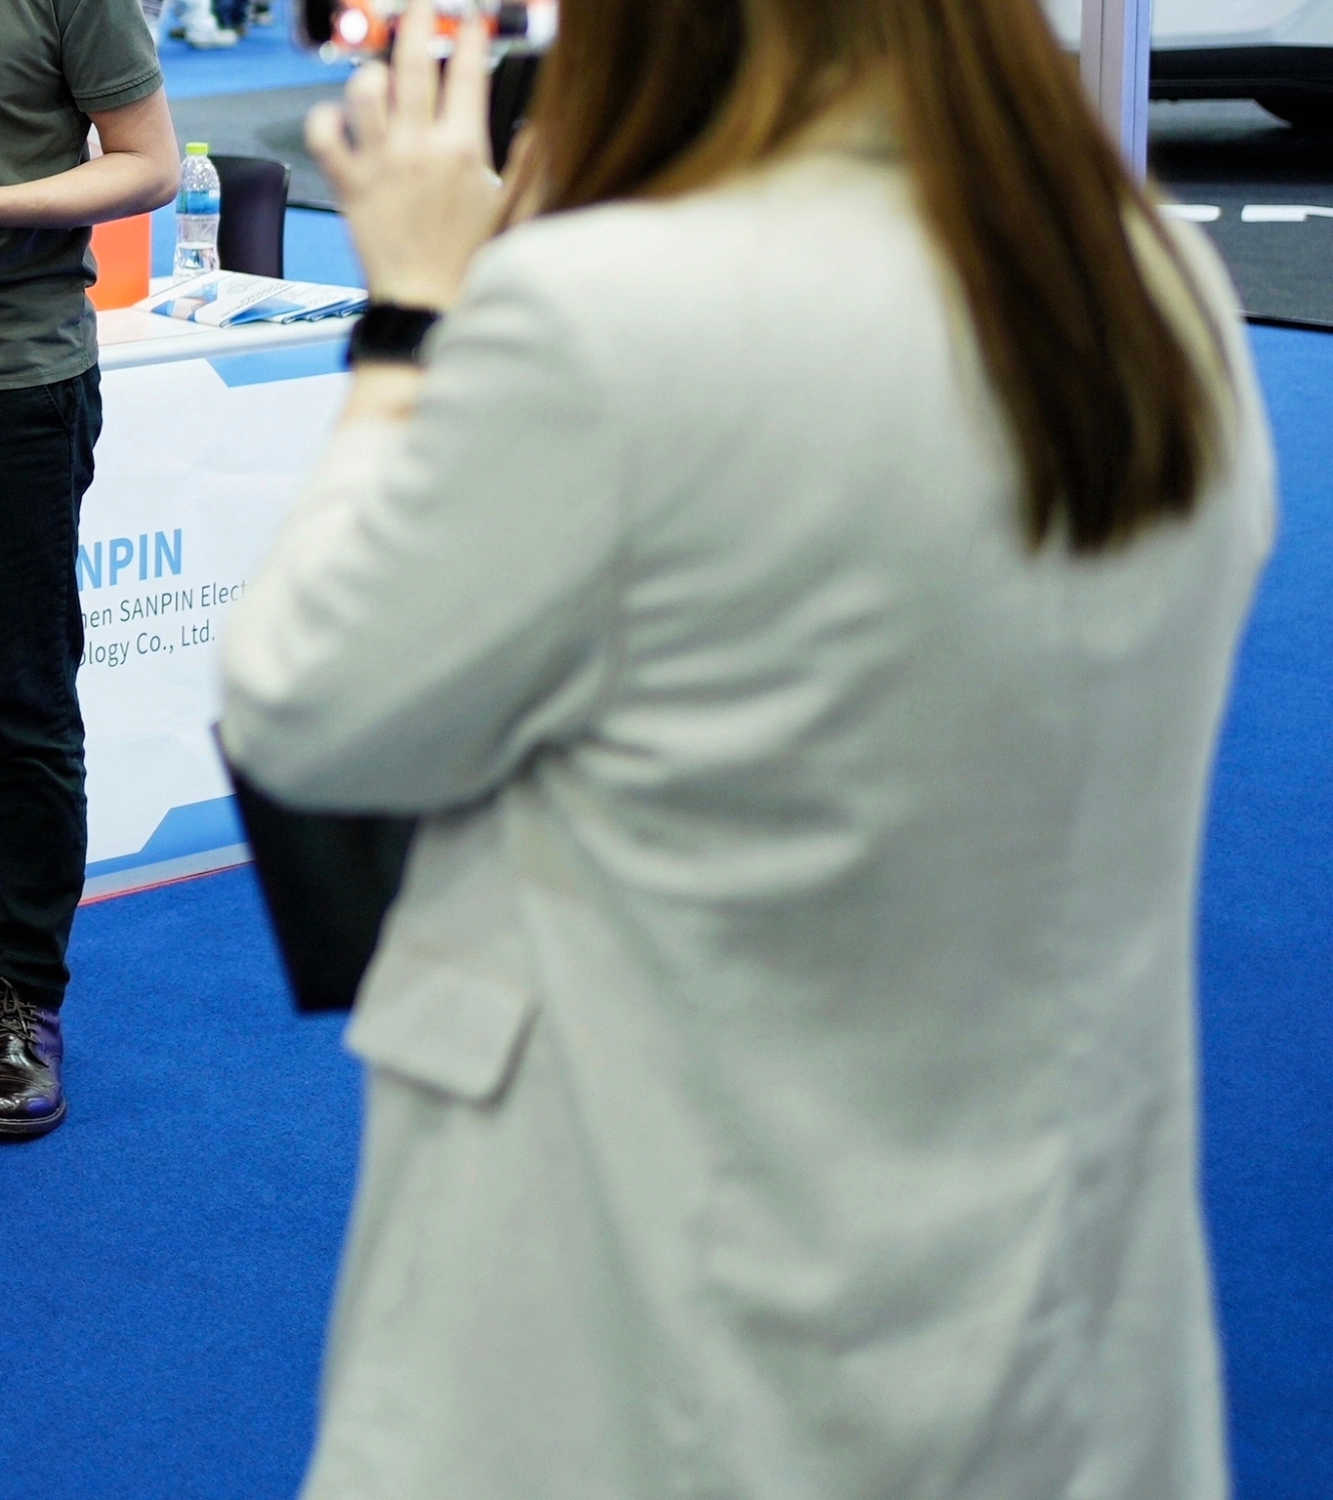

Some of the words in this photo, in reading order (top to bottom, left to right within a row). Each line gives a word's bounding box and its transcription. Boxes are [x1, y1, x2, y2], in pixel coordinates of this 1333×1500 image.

[76, 528, 183, 592] NPIN
[120, 589, 194, 622] SANPIN
[201, 579, 247, 609] Elect
[136, 631, 174, 654] Co.,
[181, 619, 216, 647] Ltd.
